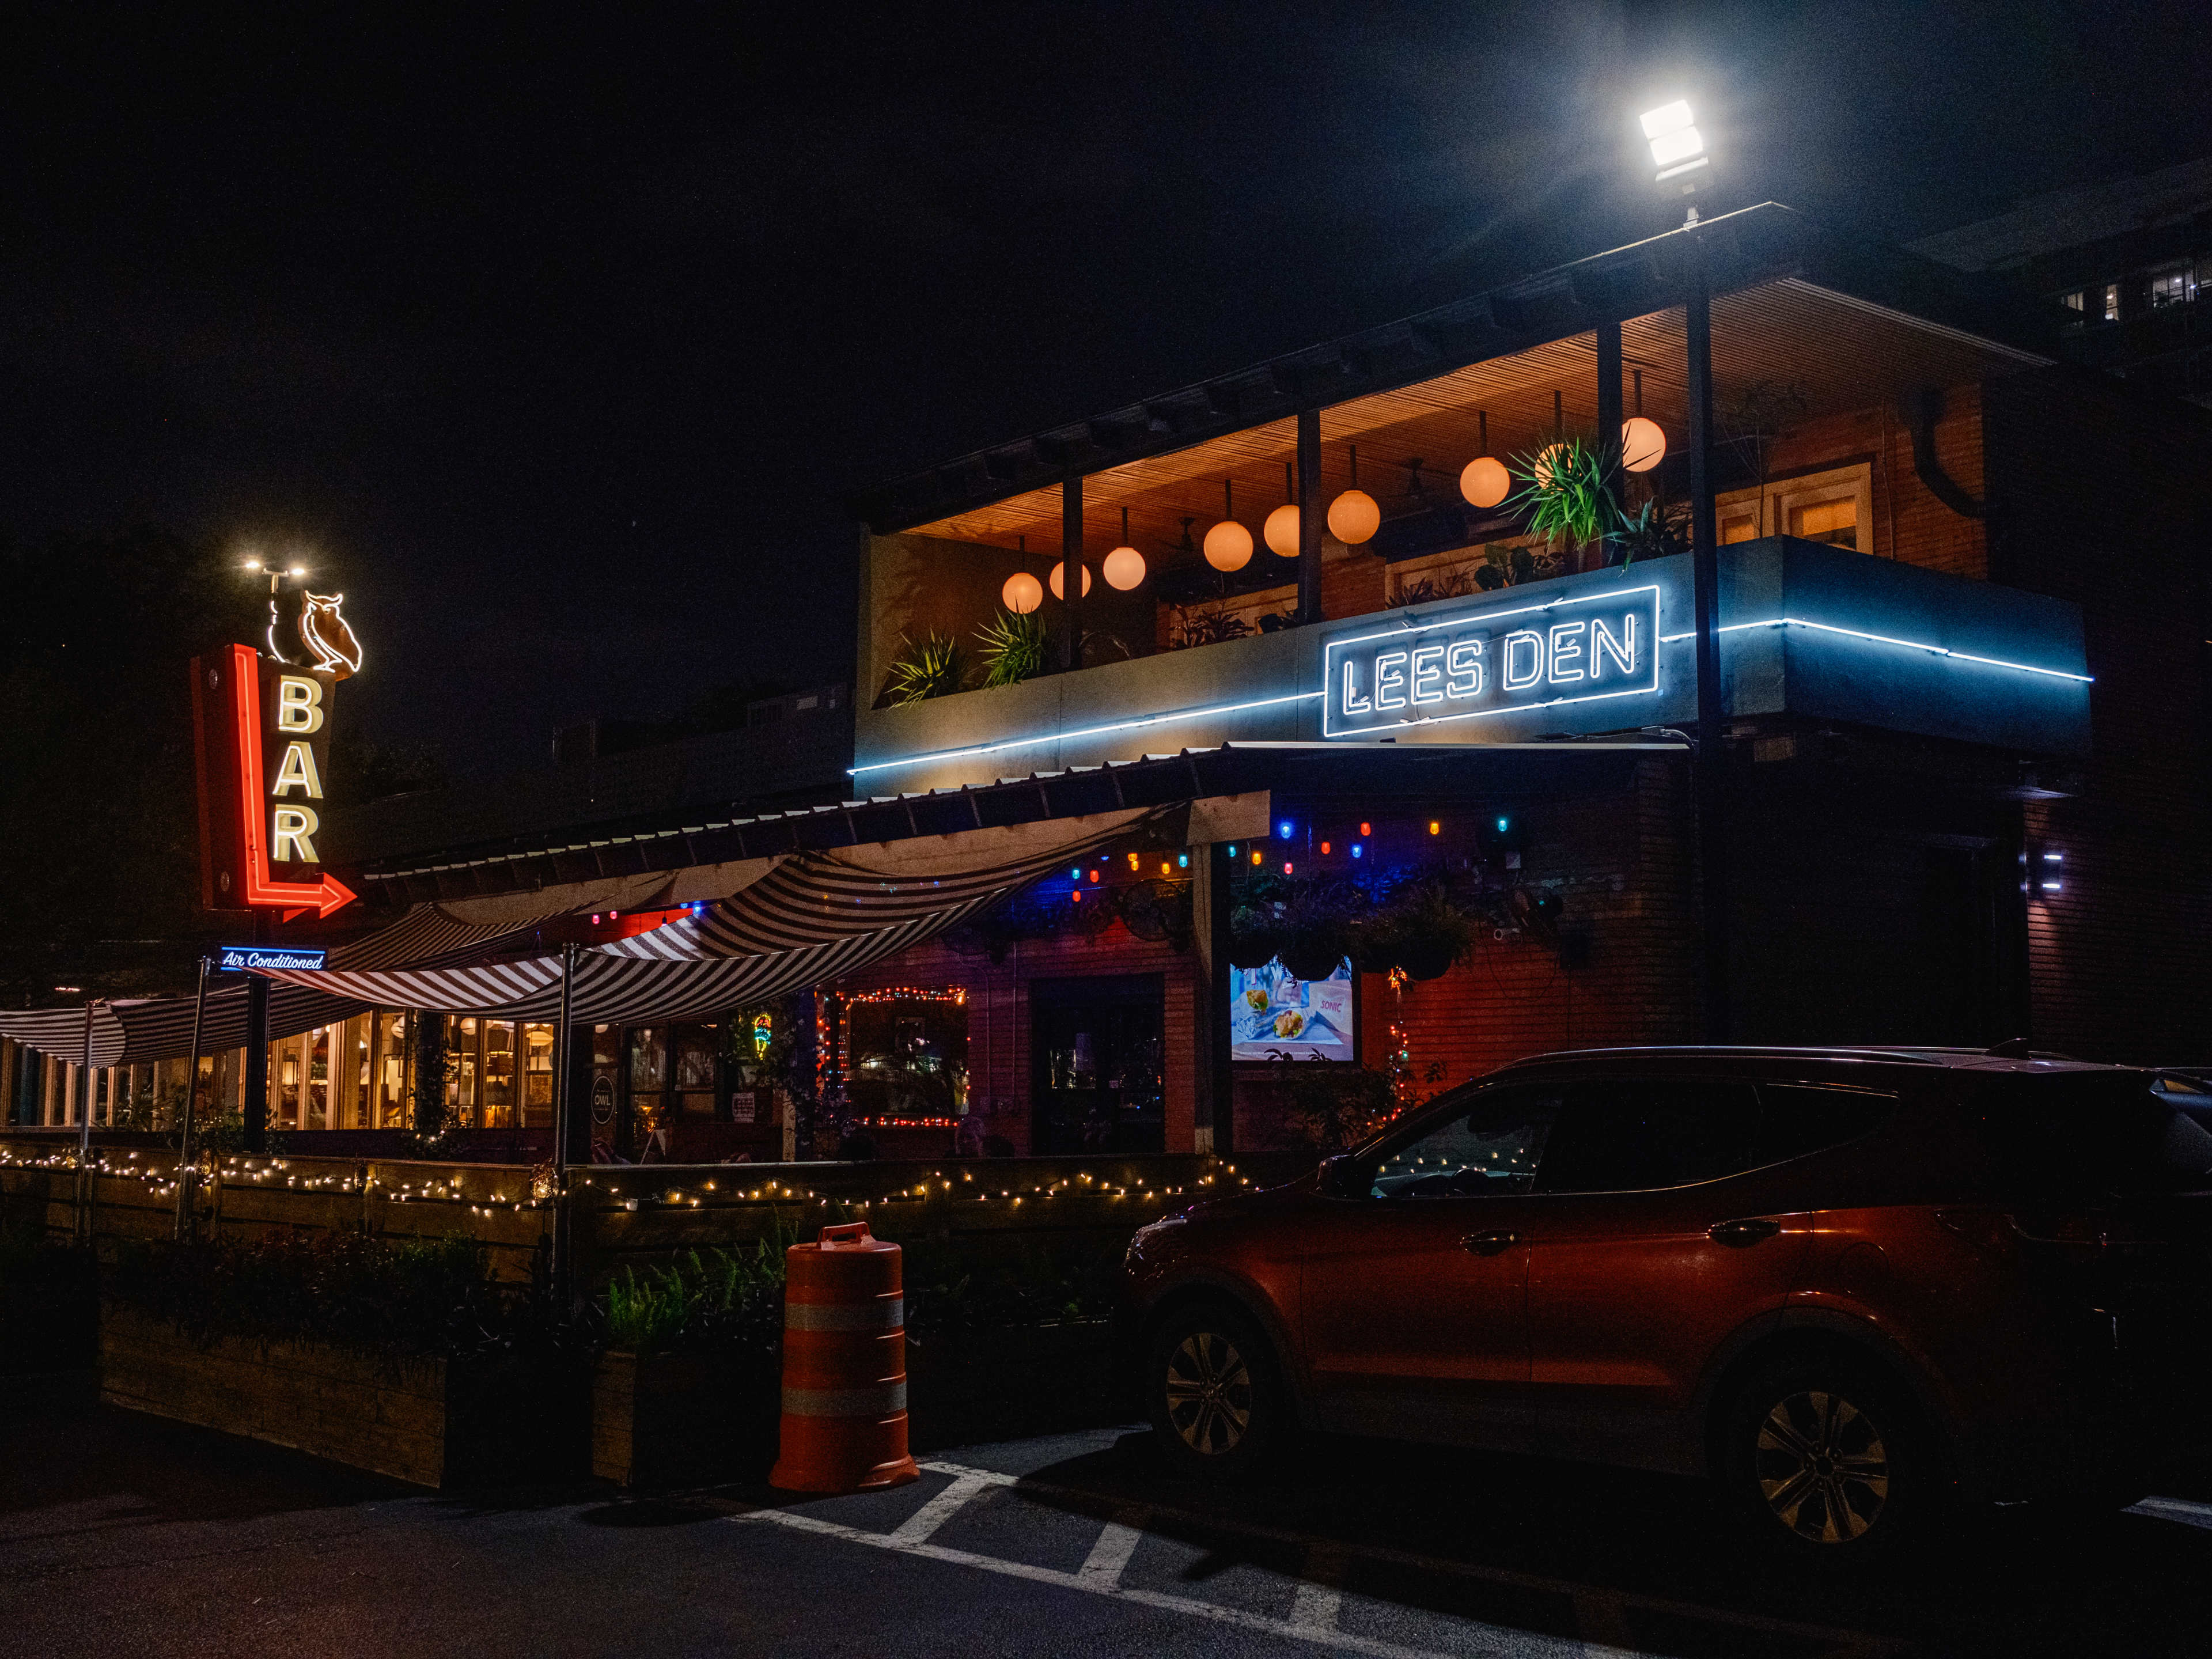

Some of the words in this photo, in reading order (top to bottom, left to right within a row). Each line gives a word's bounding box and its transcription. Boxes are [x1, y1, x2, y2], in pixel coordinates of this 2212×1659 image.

[1343, 639, 1483, 715] LEES
[1502, 614, 1635, 691] DEN
[272, 675, 324, 862] BAR
[222, 951, 245, 967] Air
[247, 952, 324, 969] Conditioned
[1320, 1000, 1342, 1013] SONIC
[594, 1094, 611, 1105] OWL
